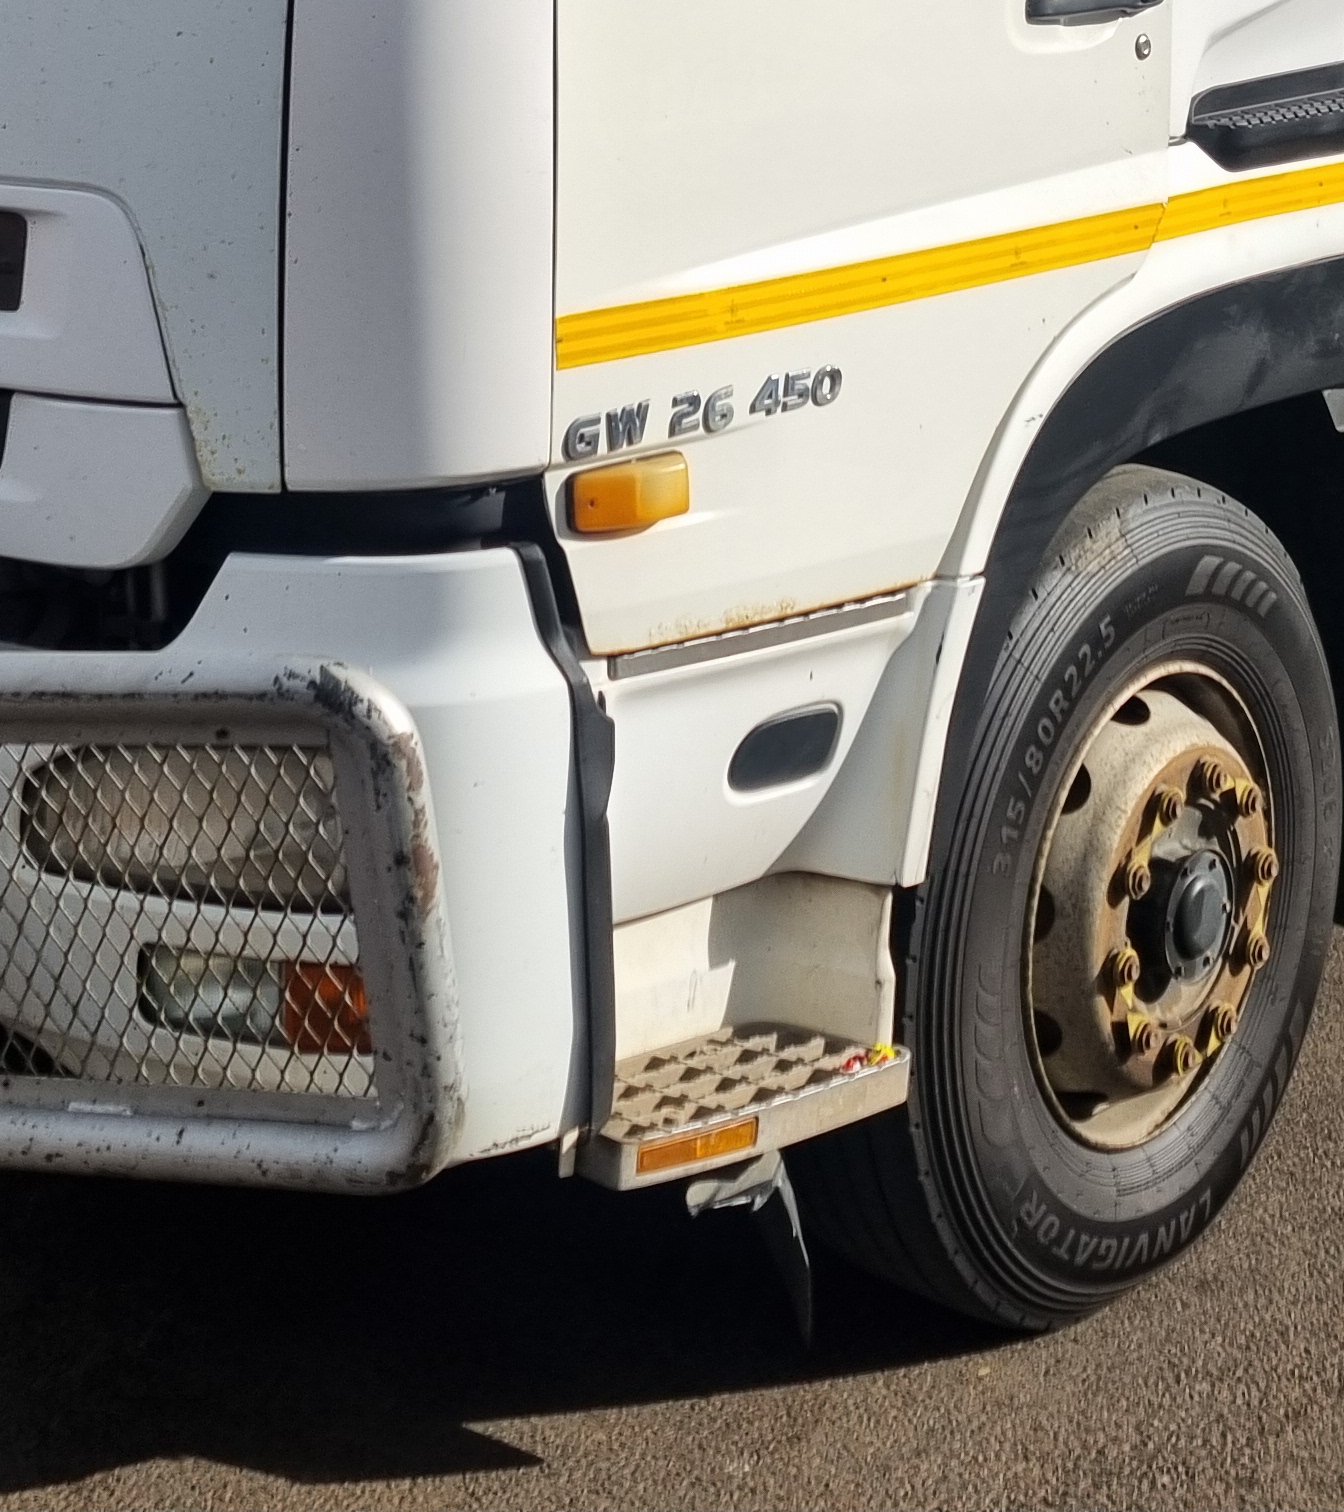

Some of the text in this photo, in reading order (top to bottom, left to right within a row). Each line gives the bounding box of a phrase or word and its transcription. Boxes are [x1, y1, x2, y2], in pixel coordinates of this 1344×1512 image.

[561, 363, 844, 462] GW 26 450
[990, 613, 1116, 876] 315/80R22.5
[1018, 1186, 1213, 1271] LANVIGATOR
